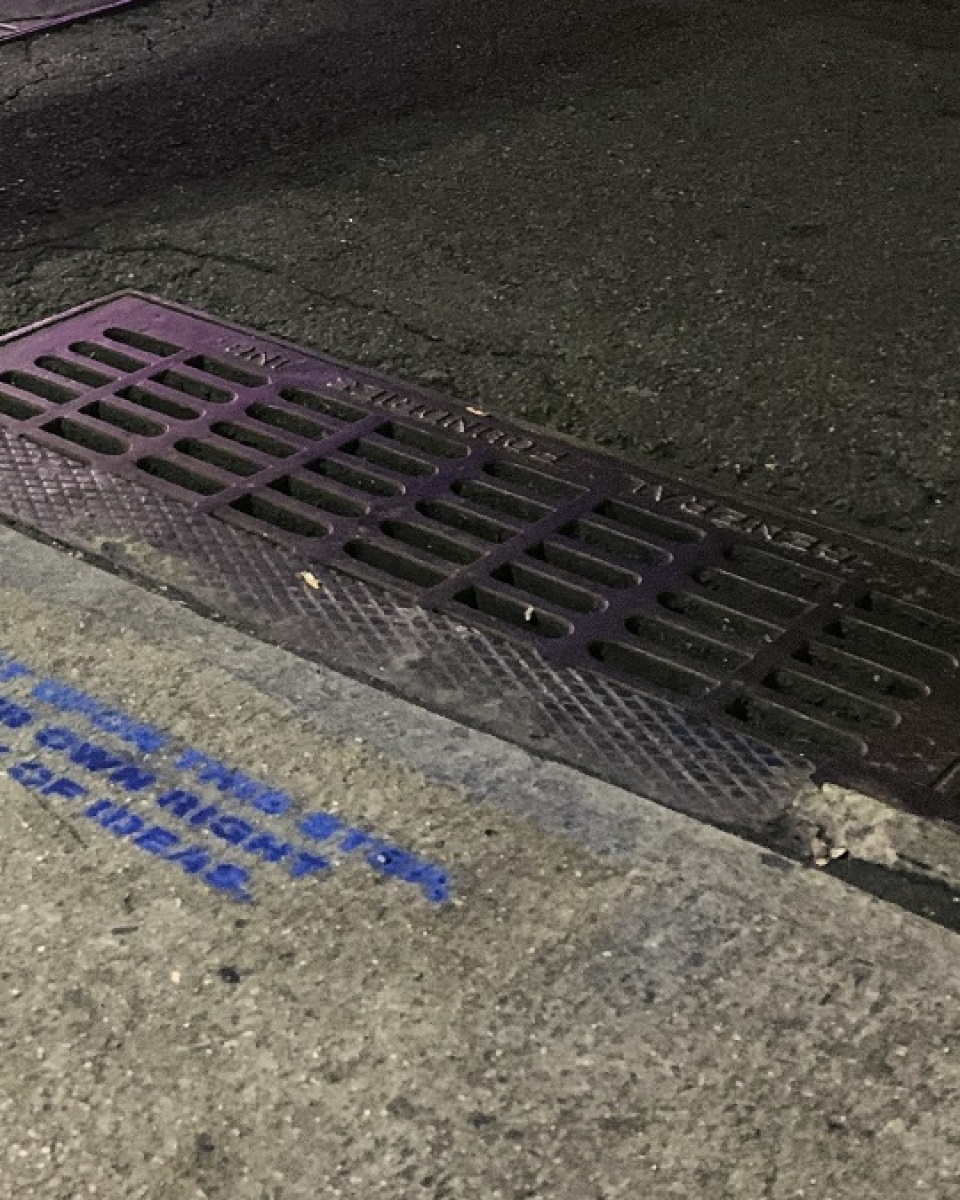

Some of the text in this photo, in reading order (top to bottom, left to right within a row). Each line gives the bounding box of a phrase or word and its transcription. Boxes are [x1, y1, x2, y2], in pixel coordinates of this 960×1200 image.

[7, 760, 88, 800] OF
[34, 726, 158, 793] OWN
[157, 788, 330, 878] RIGHT
